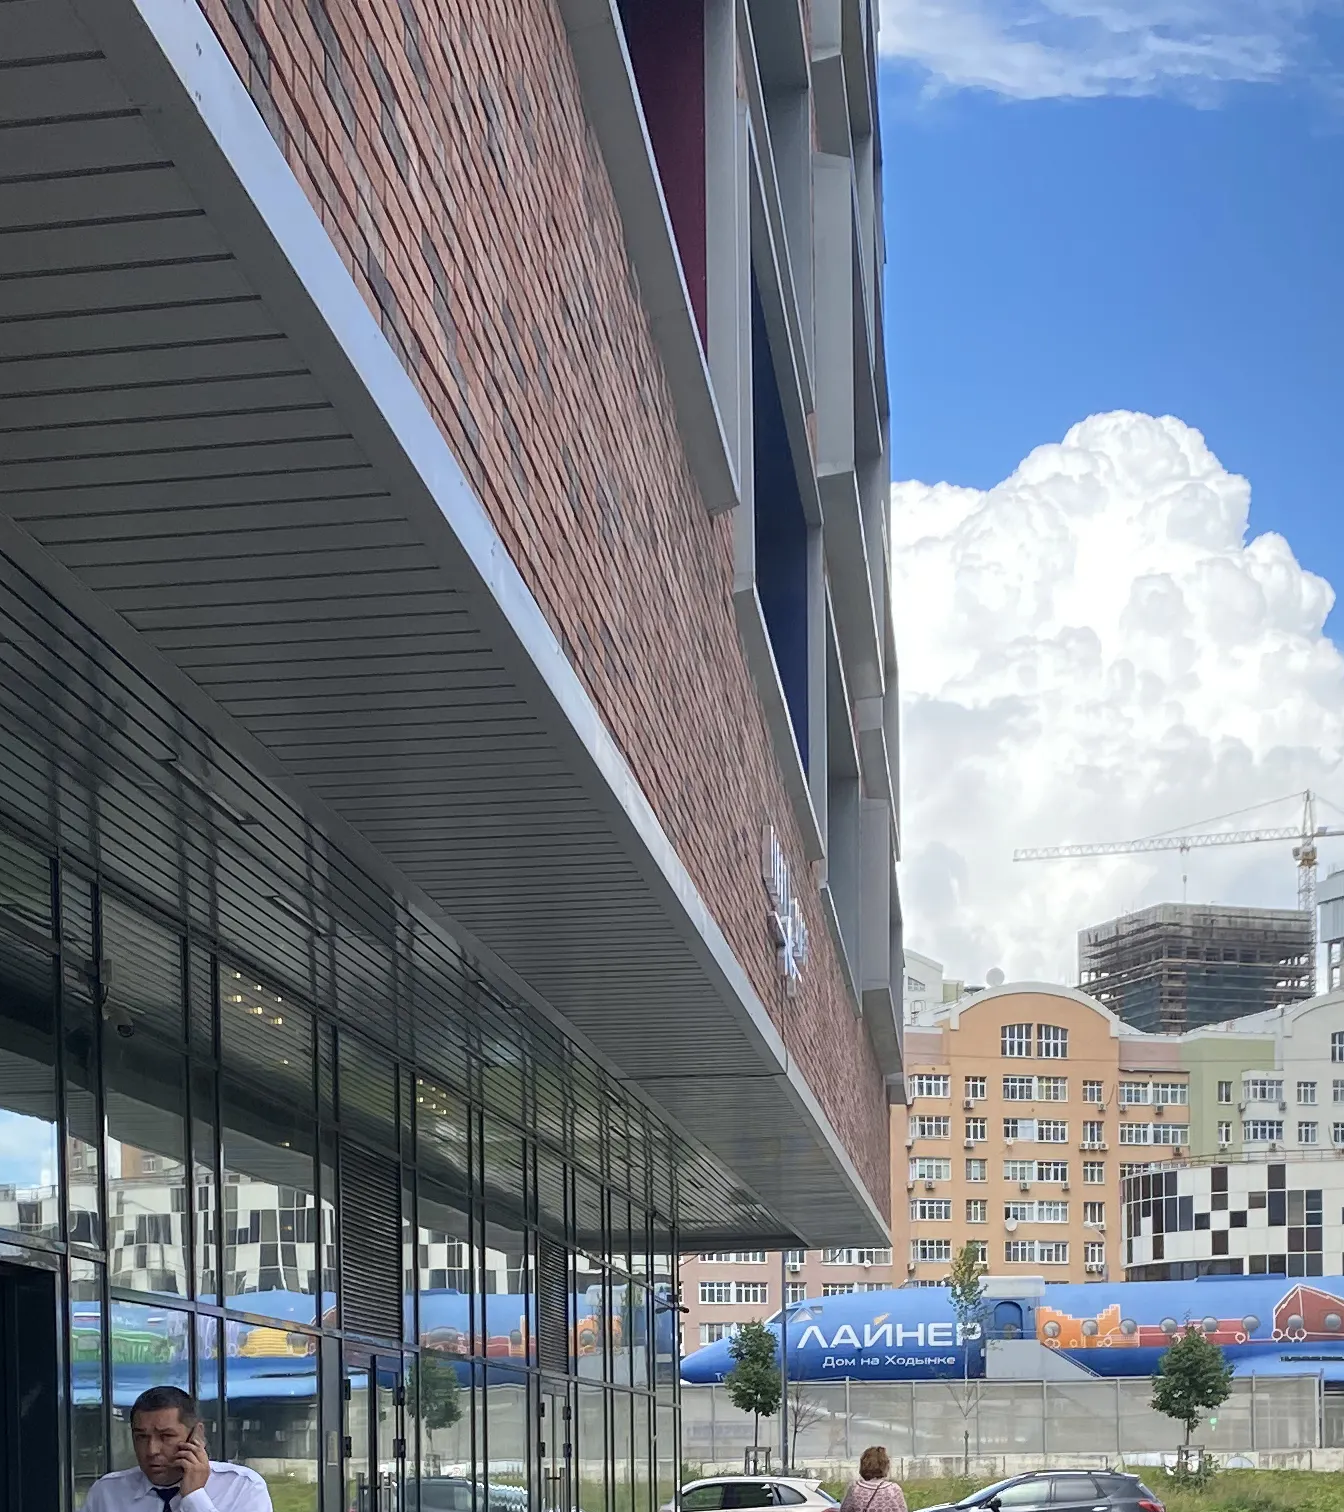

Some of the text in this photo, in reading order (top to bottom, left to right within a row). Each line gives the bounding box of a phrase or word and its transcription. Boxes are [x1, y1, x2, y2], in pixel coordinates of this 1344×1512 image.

[797, 1314, 982, 1349] ЛАЙНЕР
[822, 1354, 956, 1369] Дом на Ходынке
